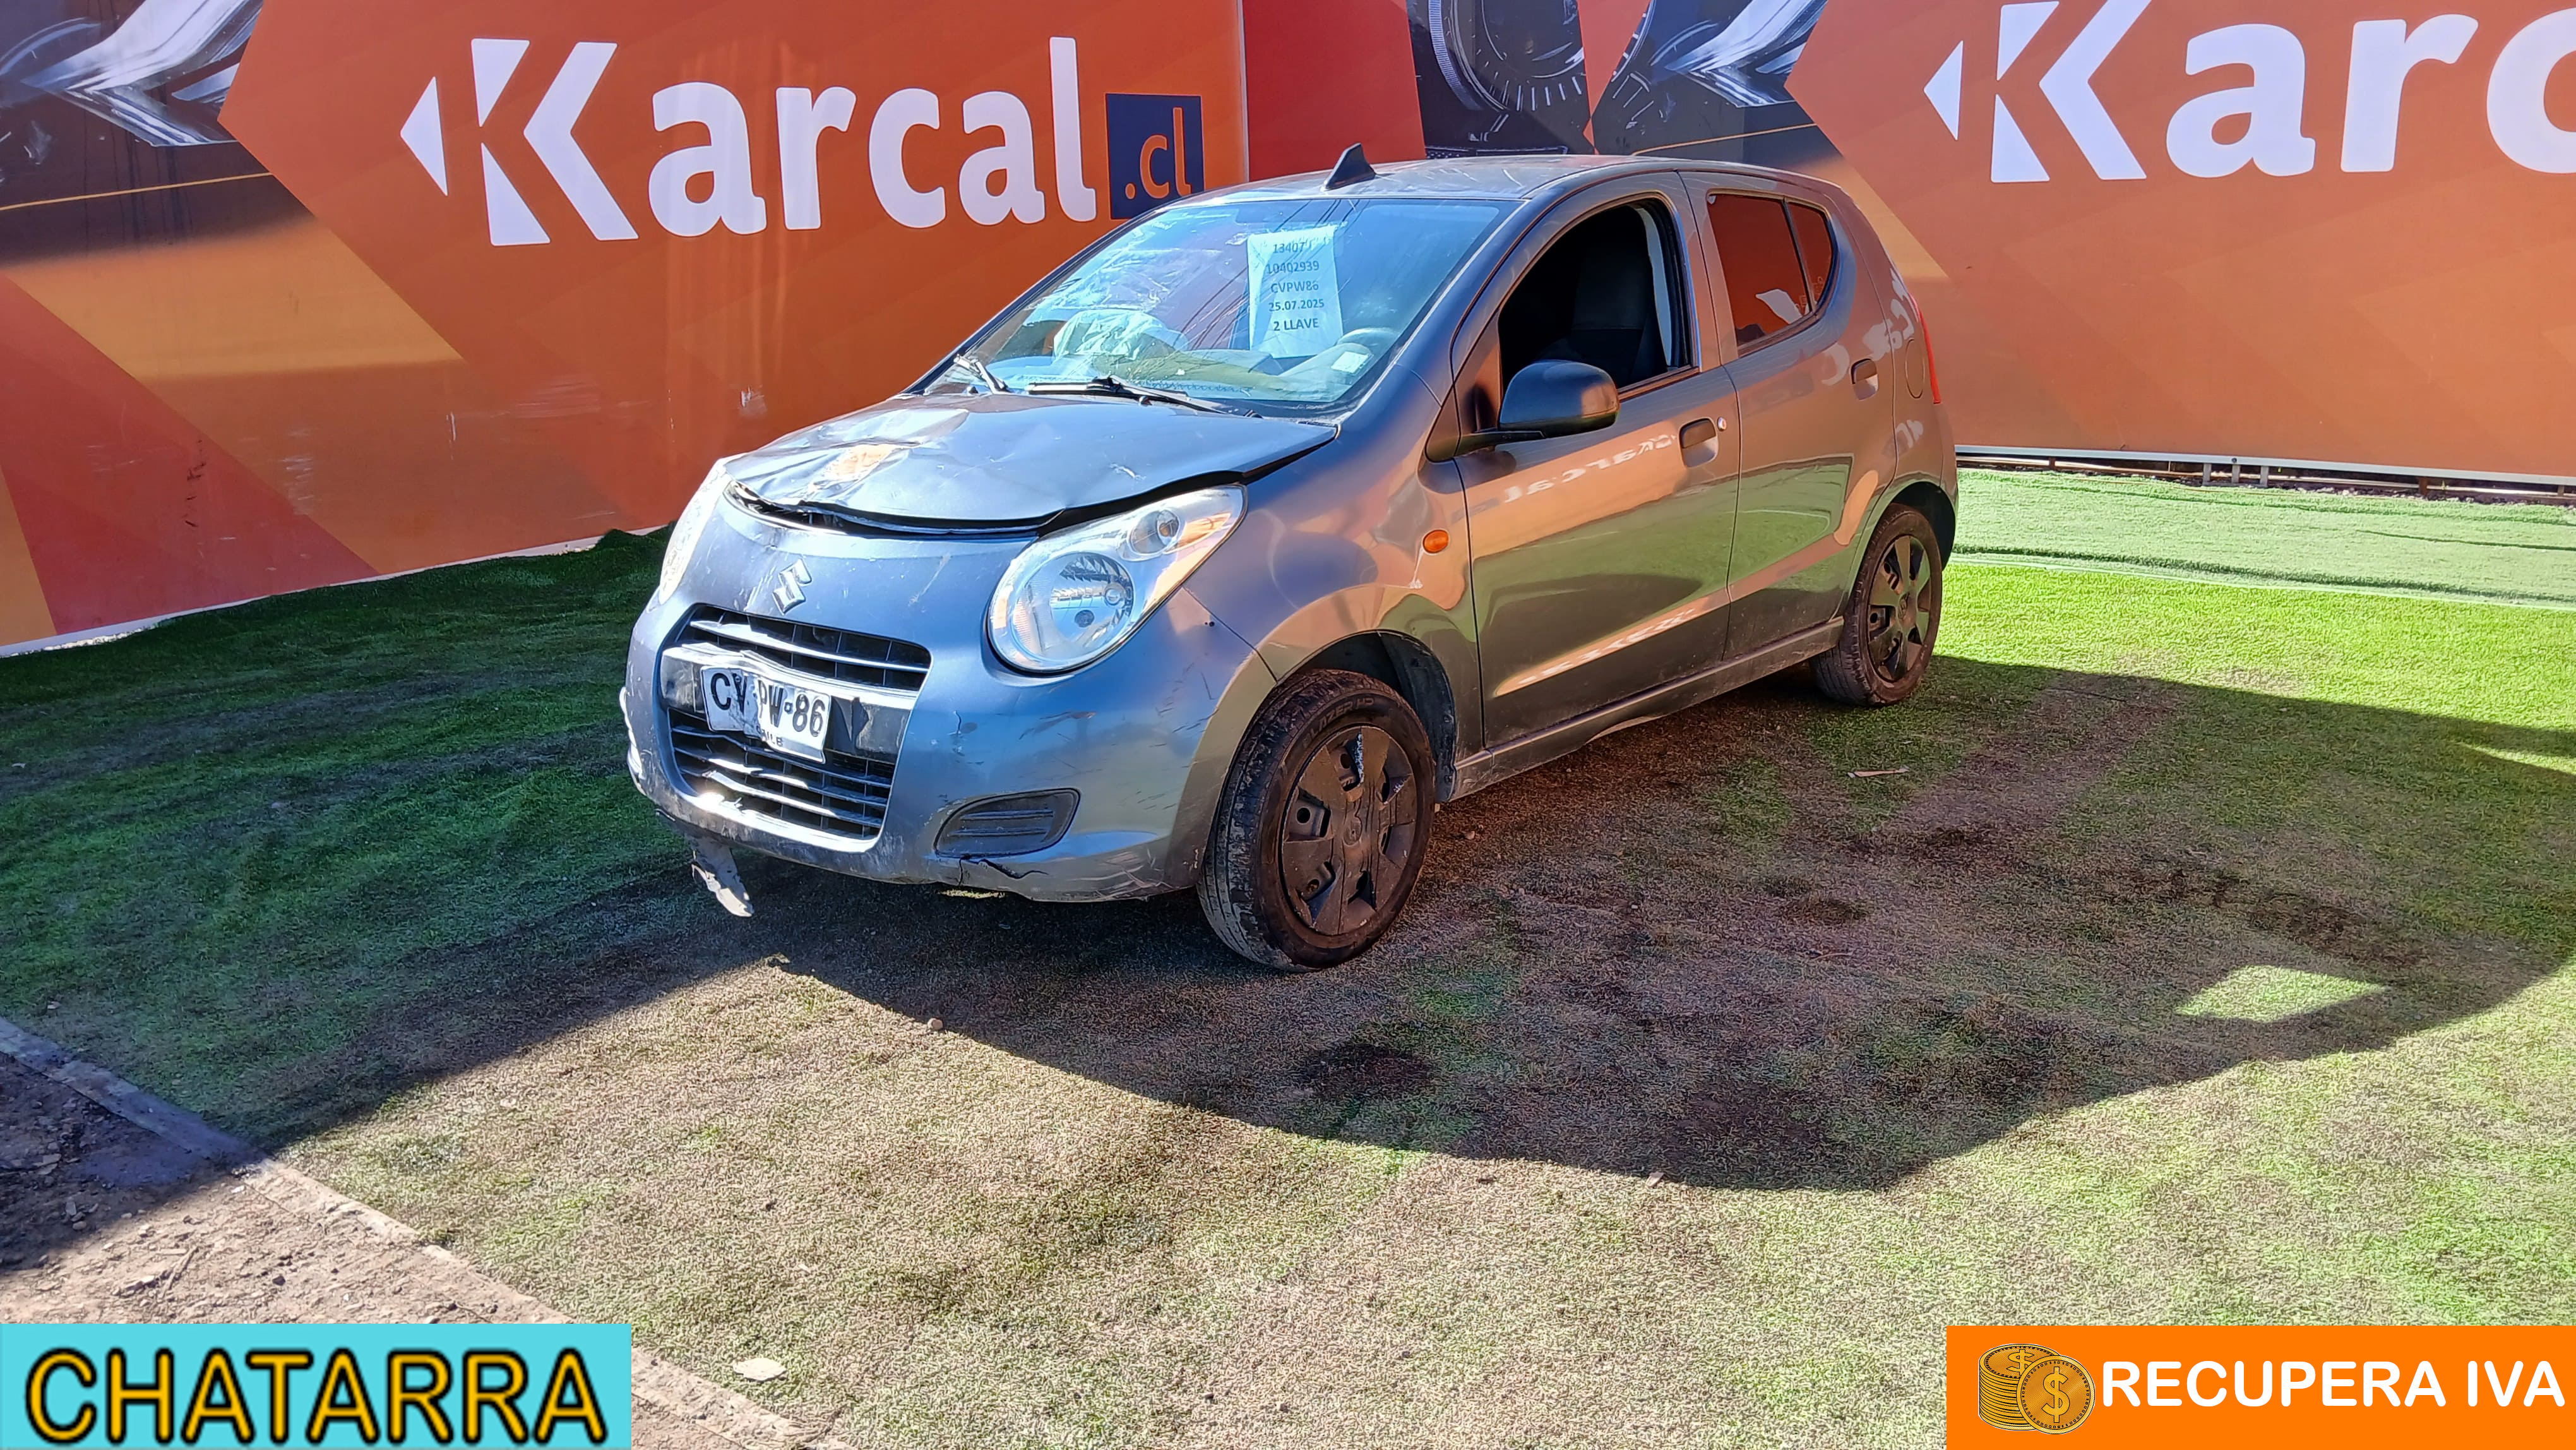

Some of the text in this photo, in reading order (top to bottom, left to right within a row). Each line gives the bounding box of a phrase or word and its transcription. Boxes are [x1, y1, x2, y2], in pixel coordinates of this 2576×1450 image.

[470, 36, 1097, 246] Karcal
[1266, 261, 1320, 274] 10402939
[1270, 281, 1319, 294] CVPW86
[1268, 299, 1325, 311] 25.07.2025
[1273, 318, 1319, 331] 2 LLAVE
